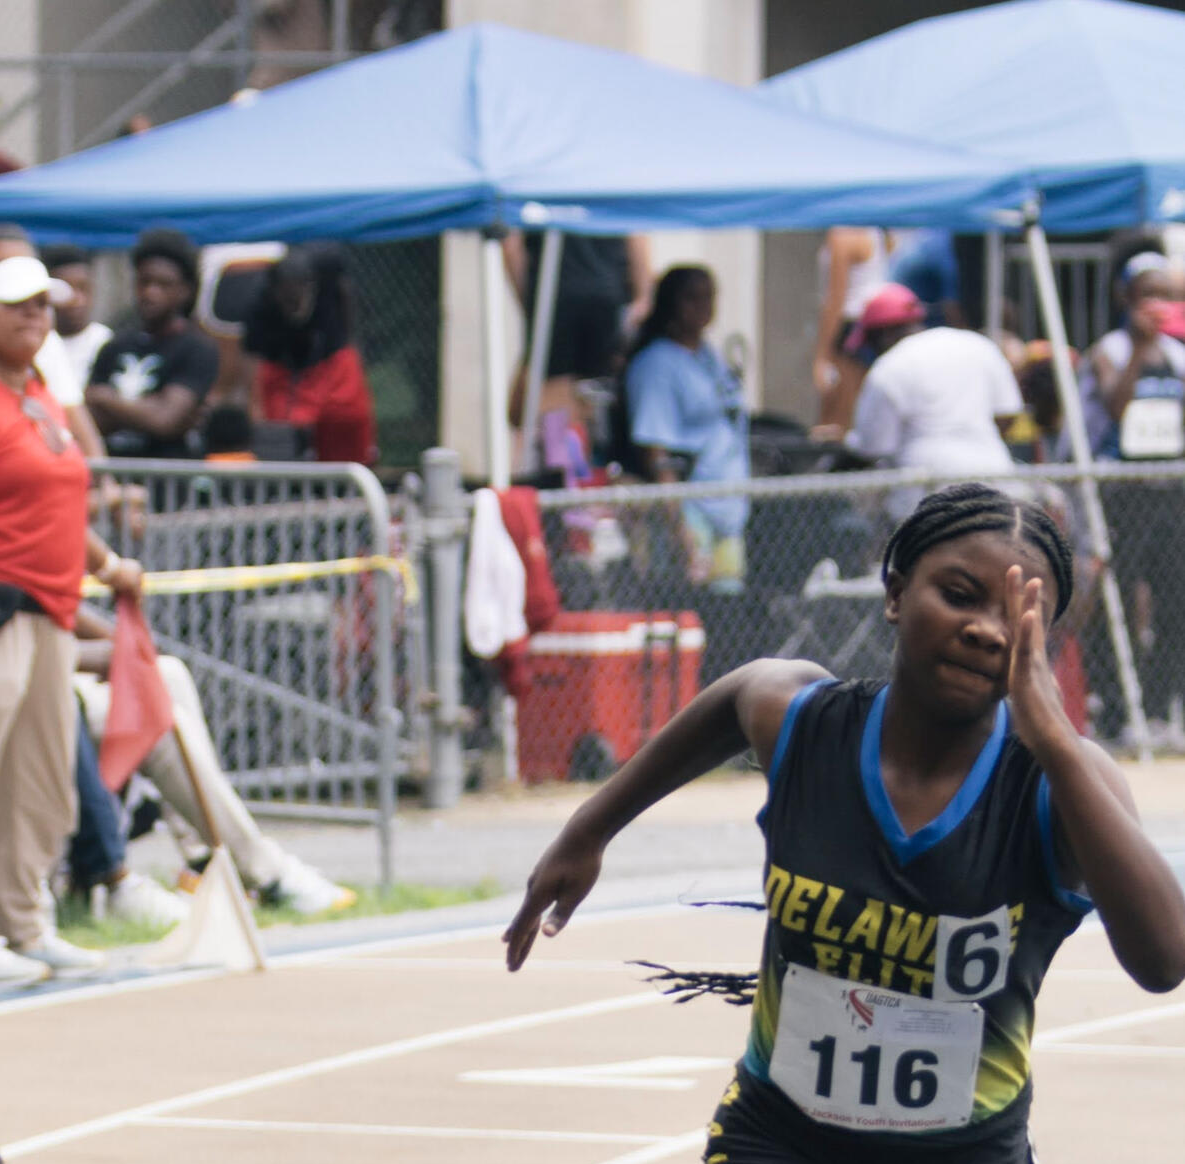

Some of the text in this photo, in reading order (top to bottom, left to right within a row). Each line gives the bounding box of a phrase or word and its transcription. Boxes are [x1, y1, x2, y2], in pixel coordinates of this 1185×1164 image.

[945, 921, 1001, 996] 6
[809, 1034, 940, 1109] 116
[856, 1117, 886, 1127] Youth
